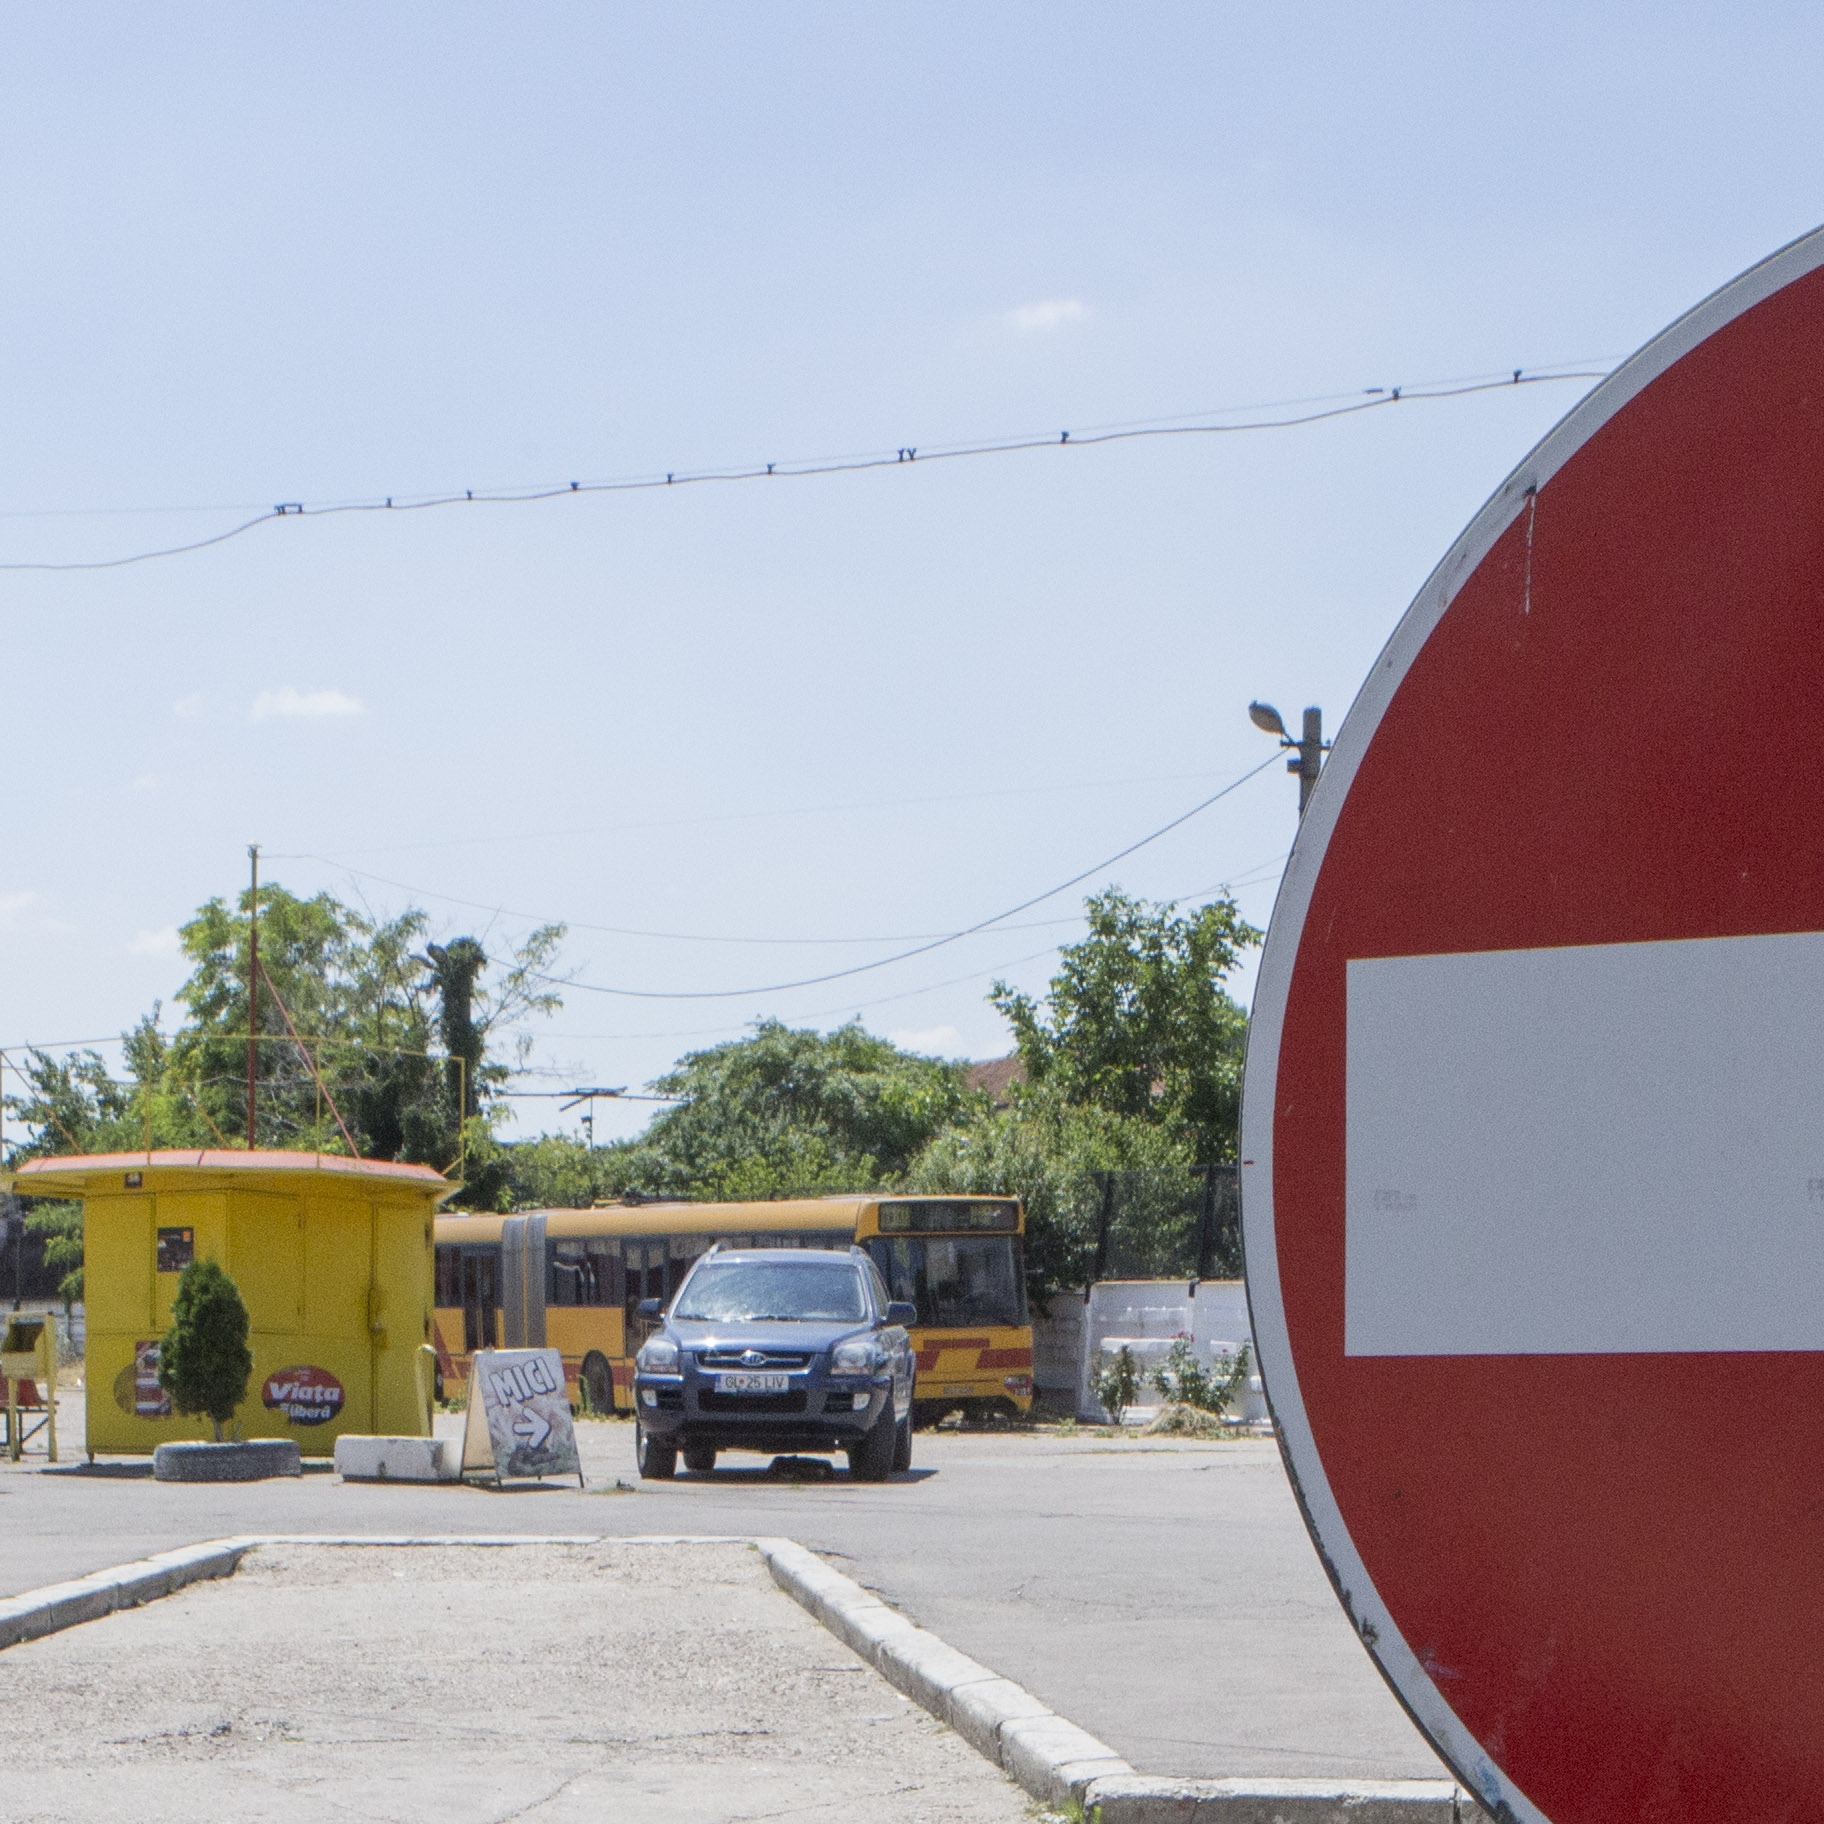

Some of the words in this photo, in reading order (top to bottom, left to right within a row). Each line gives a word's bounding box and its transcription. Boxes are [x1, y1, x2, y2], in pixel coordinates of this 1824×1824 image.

[488, 1357, 557, 1407] MICI
[747, 1376, 761, 1388] 25
[765, 1376, 785, 1388] LIV
